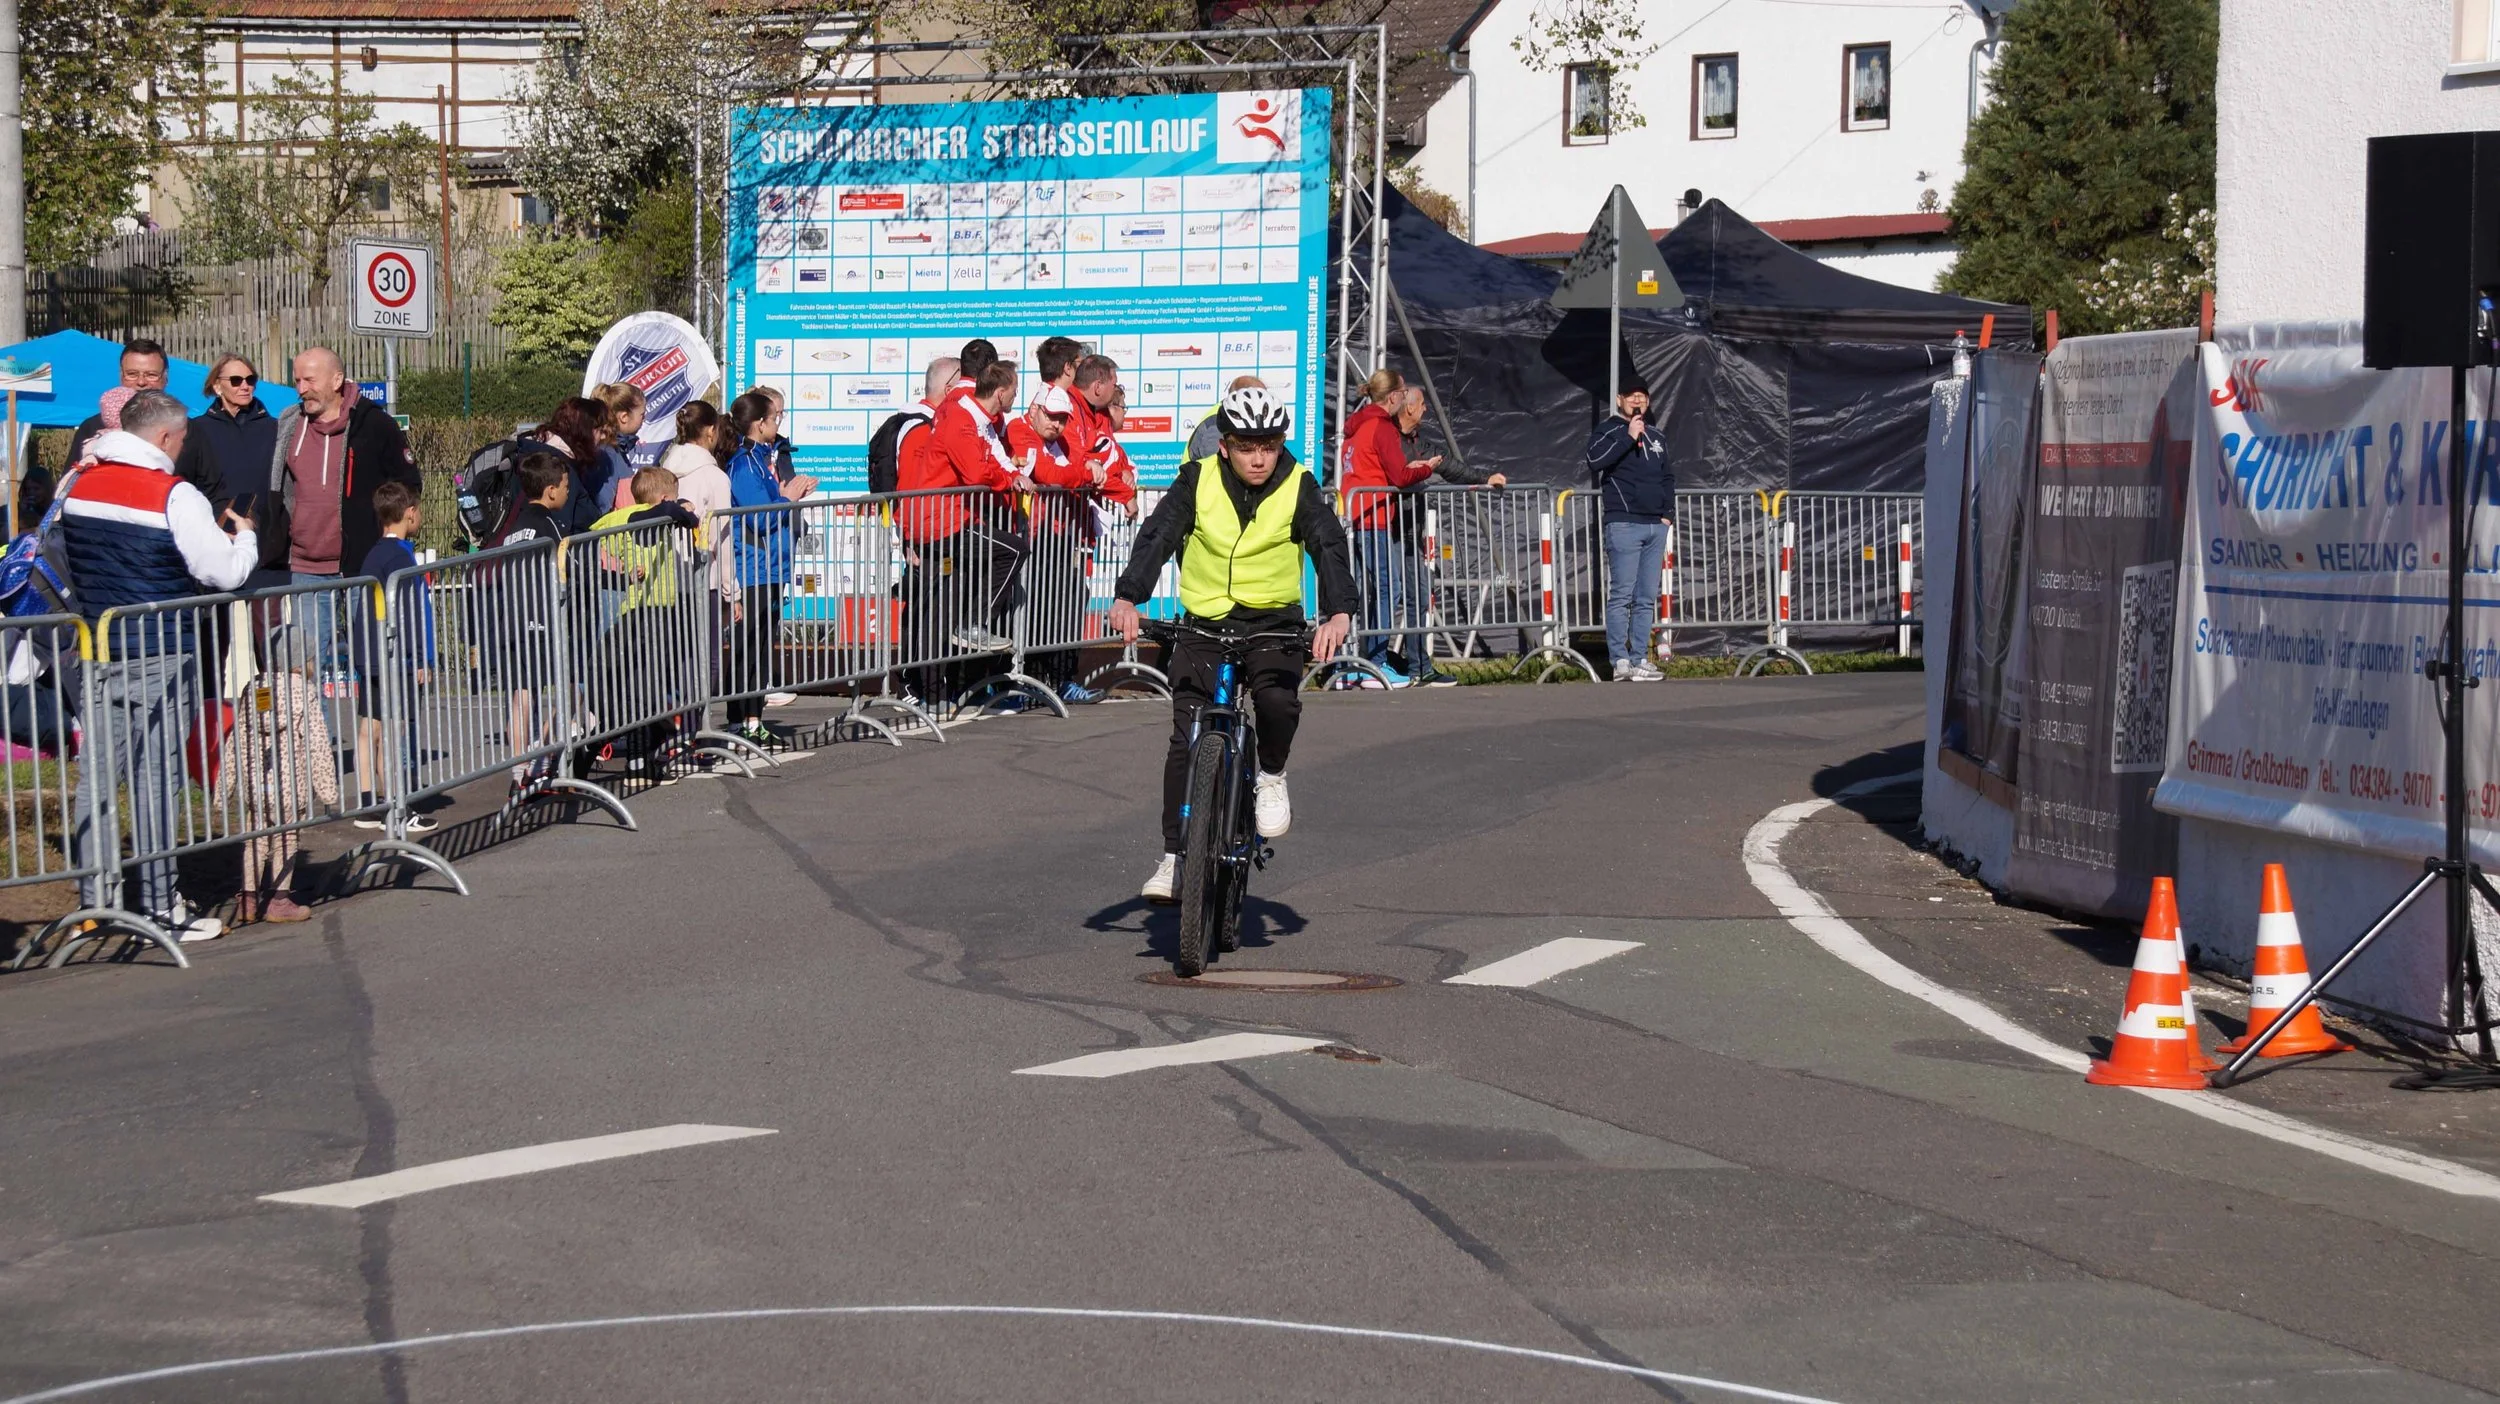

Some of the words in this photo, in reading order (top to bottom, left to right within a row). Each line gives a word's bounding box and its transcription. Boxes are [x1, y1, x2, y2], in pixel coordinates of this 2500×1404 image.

[760, 123, 968, 164] SCHÖNBACHER
[983, 118, 1207, 161] STRASSENLAUF
[1265, 224, 1296, 232] terraform
[378, 267, 406, 293] 30
[374, 310, 411, 326] ZONE
[624, 352, 643, 372] SV
[644, 383, 686, 413] ERMUTH
[2384, 421, 2405, 507] &
[2209, 537, 2288, 571] SANITÄR
[2316, 542, 2418, 573] HEIZUNG
[2187, 740, 2232, 778] Grimma
[2241, 748, 2309, 791] Großbothen
[2350, 764, 2393, 802] 034384
[2403, 771, 2432, 808] 9070
